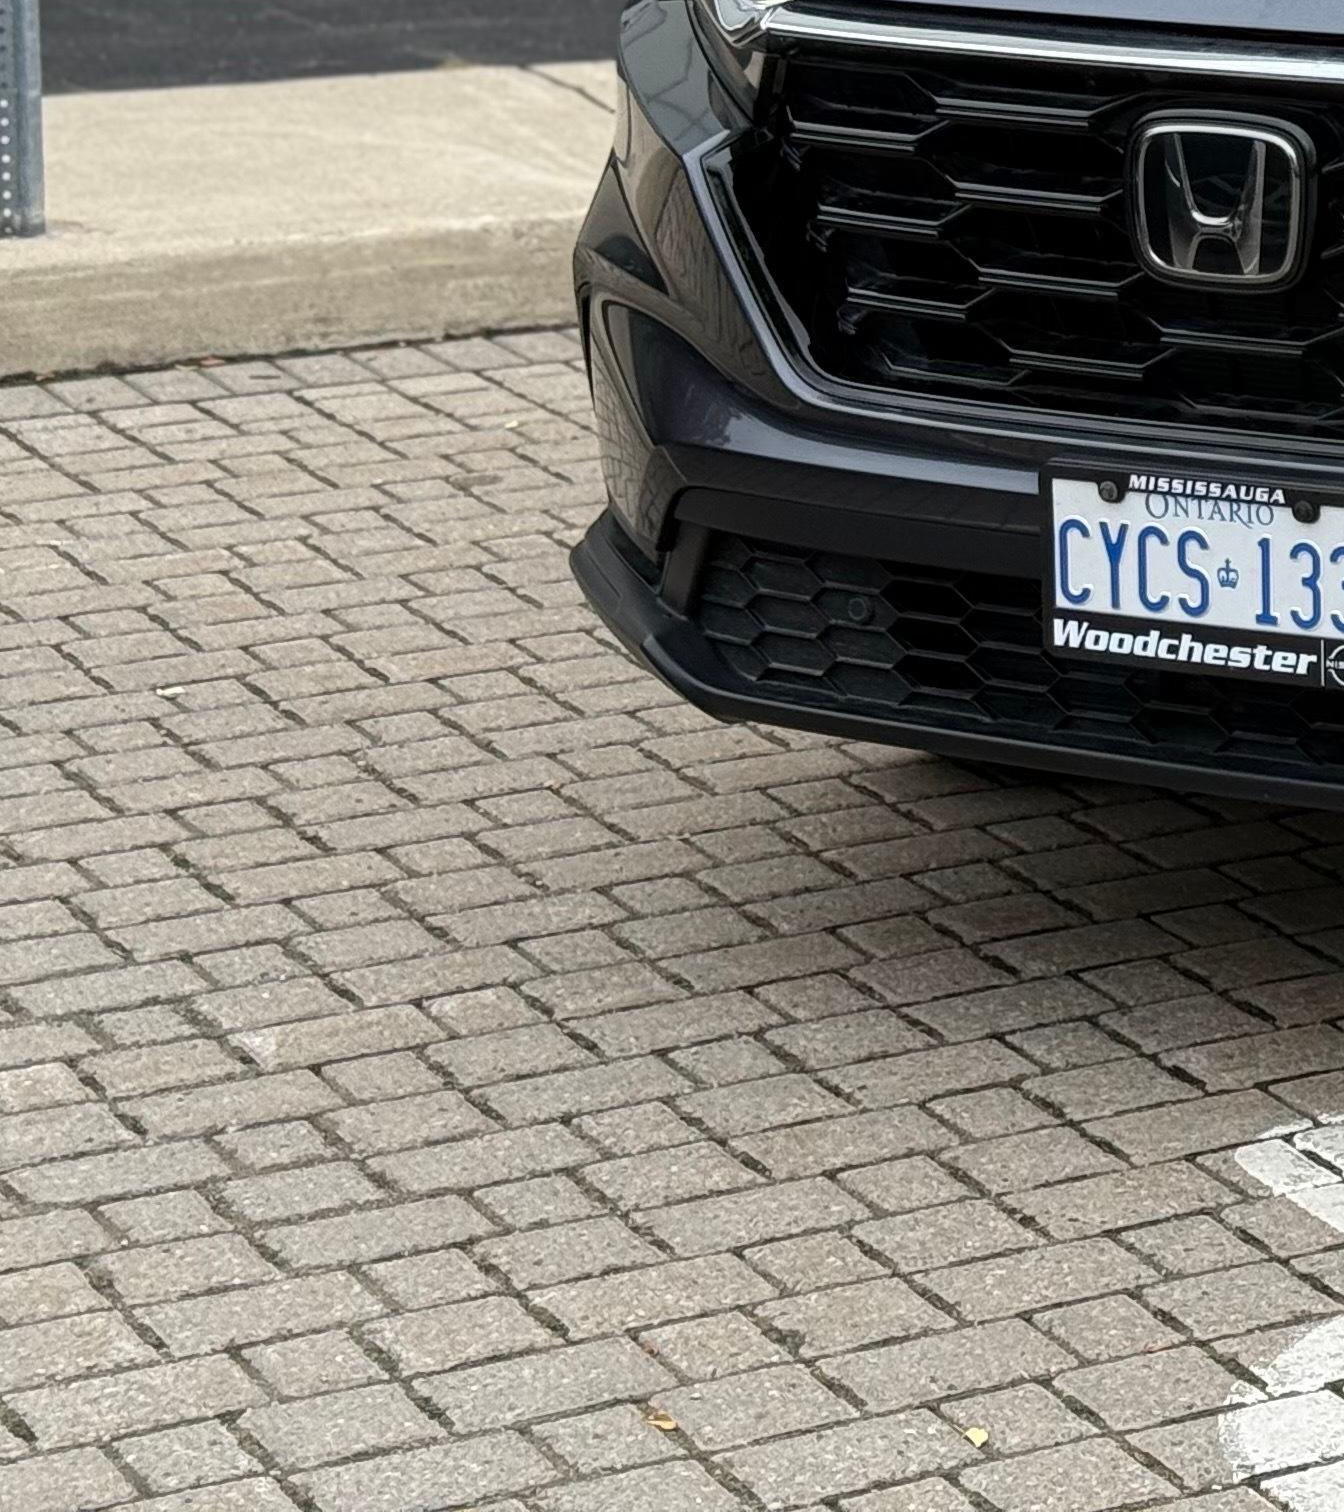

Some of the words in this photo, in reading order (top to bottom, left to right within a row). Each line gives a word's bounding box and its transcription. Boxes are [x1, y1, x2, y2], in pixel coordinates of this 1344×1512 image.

[1128, 474, 1286, 504] MISSISSAUGA
[1145, 494, 1275, 529] ONTARIO
[1052, 618, 1318, 676] Woodchester
